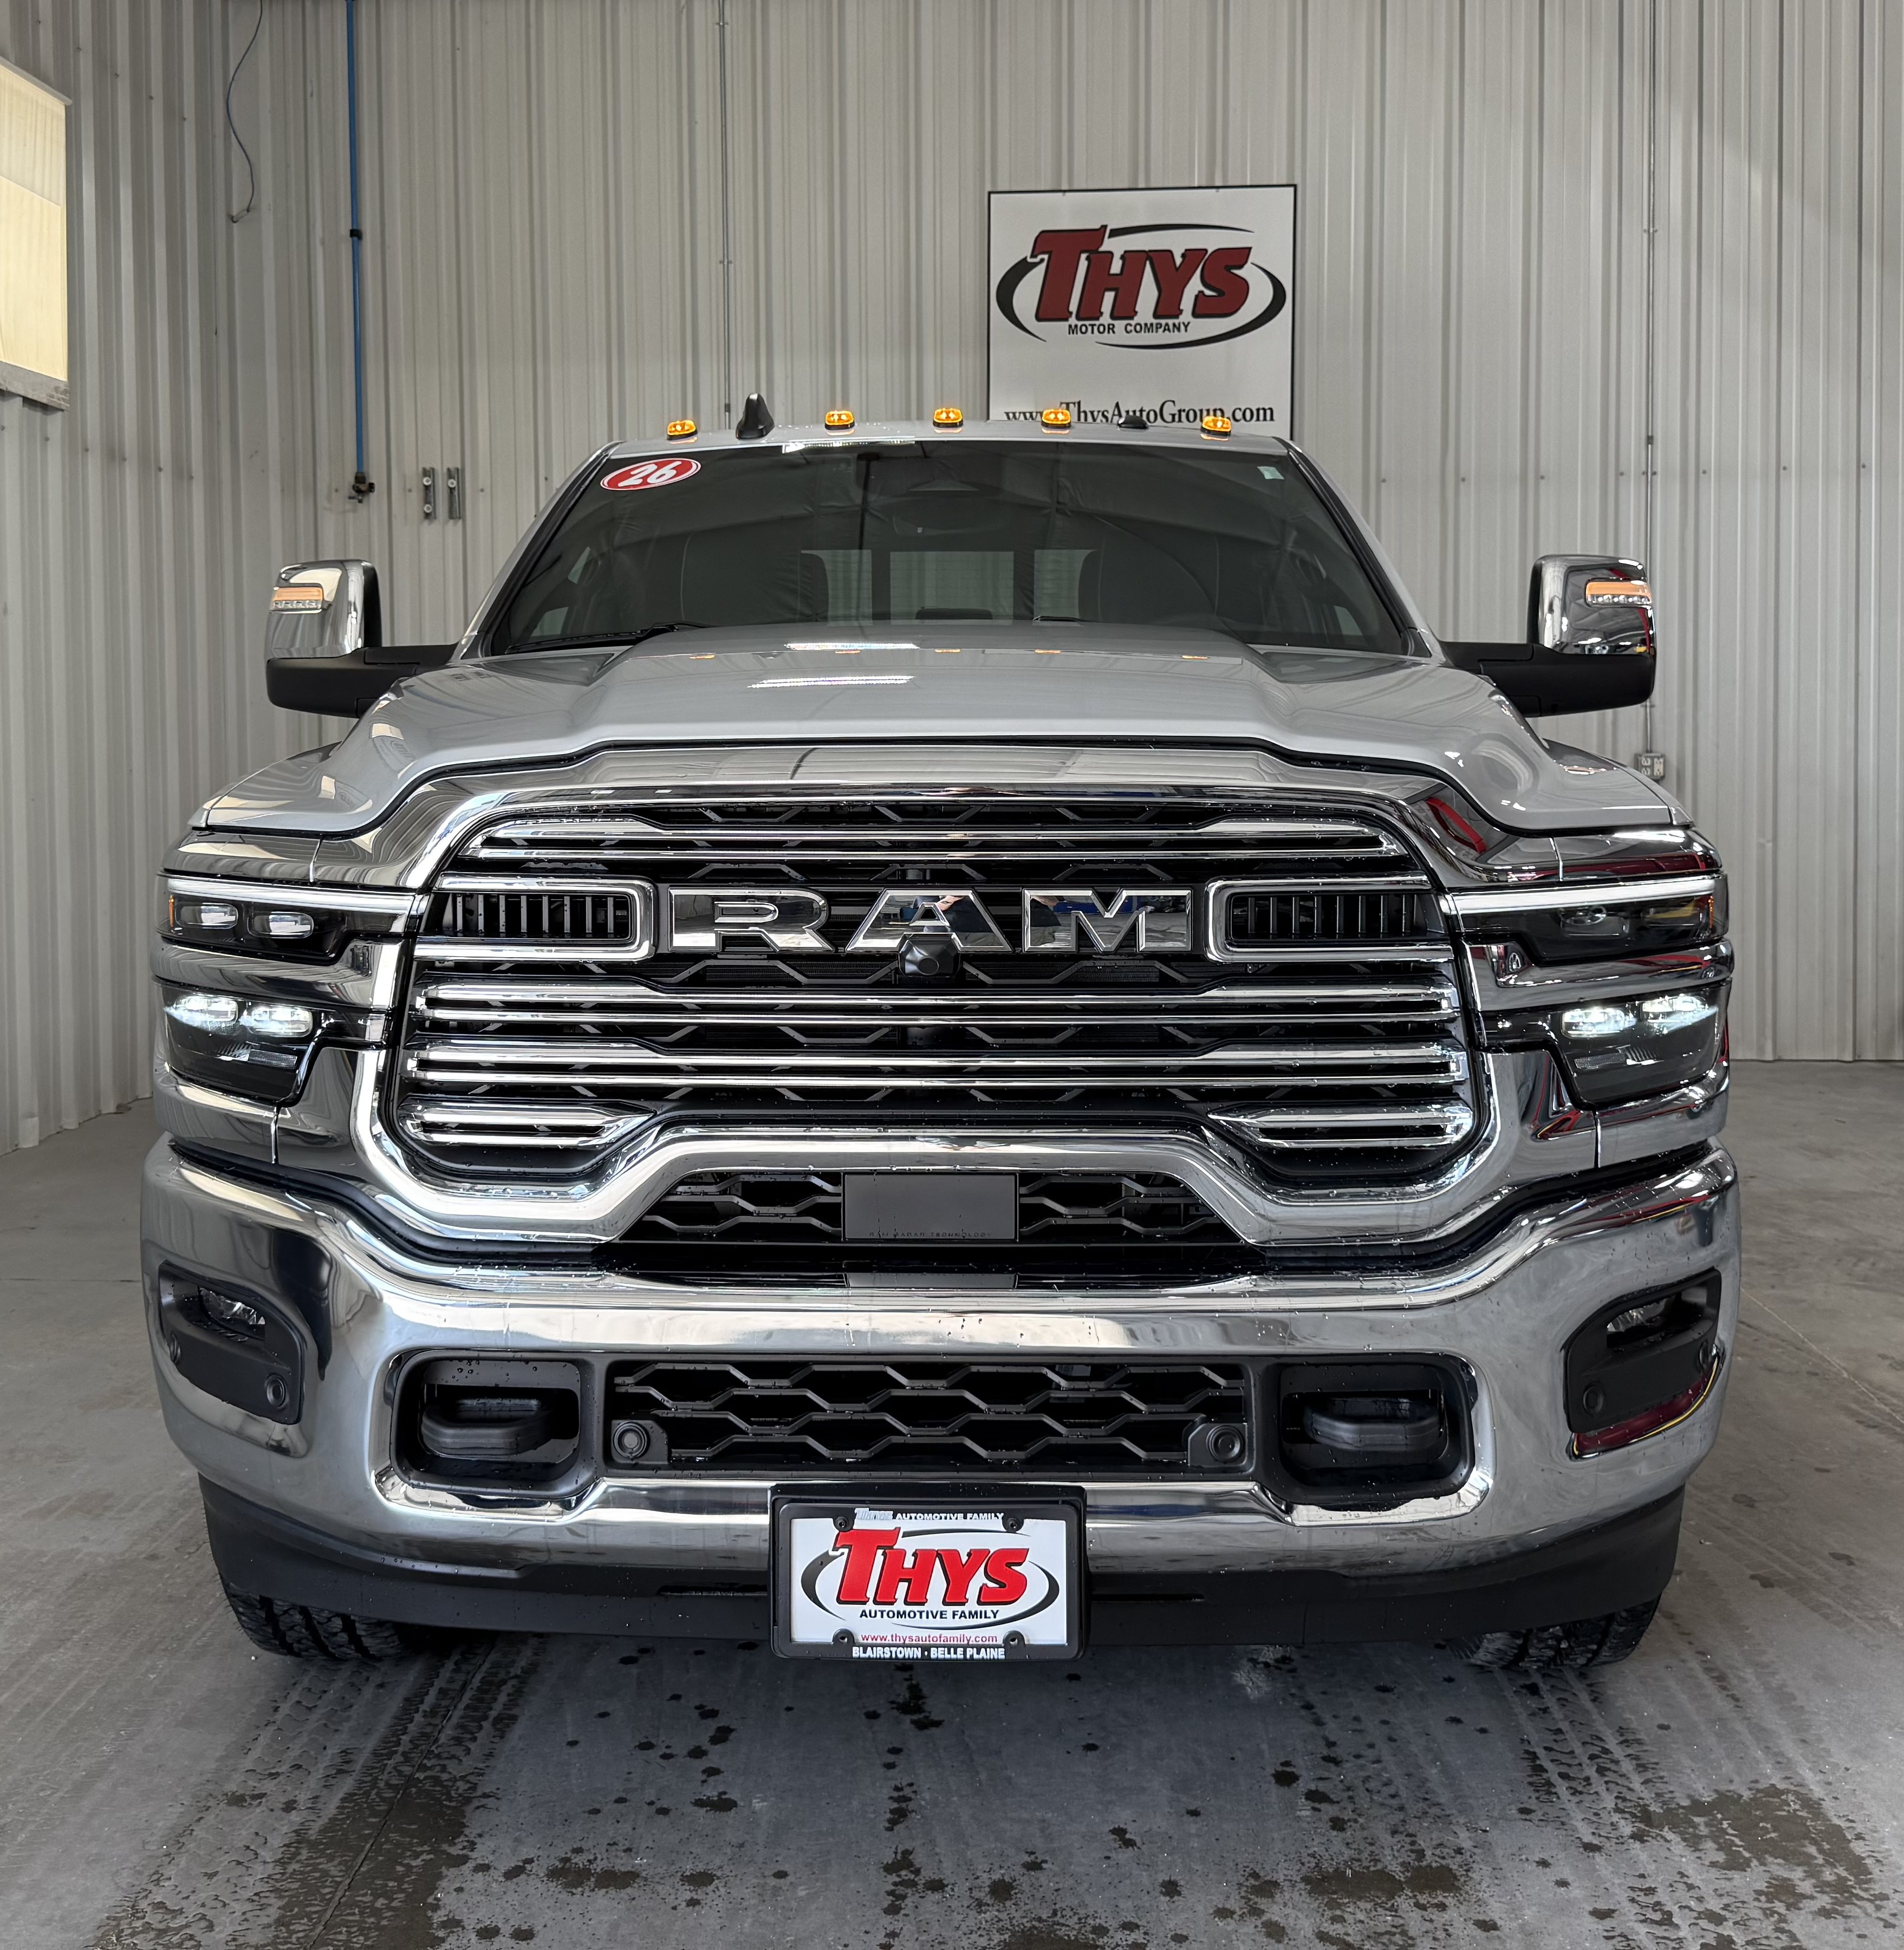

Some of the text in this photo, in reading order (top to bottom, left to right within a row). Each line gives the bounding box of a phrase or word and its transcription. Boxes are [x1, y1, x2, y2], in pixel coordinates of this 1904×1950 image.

[1031, 224, 1252, 322] THYS
[1068, 322, 1191, 335] MOTOR COMPANY
[618, 461, 682, 487] 26
[667, 887, 1192, 953] RAM
[835, 1527, 1029, 1606] THYS
[860, 1609, 999, 1619] AUTOMOTIVE FAMILY
[861, 1633, 998, 1644] www.thysautofamily.com
[852, 1646, 1005, 1659] BLAIRSTOWN BELLE PLAINE
